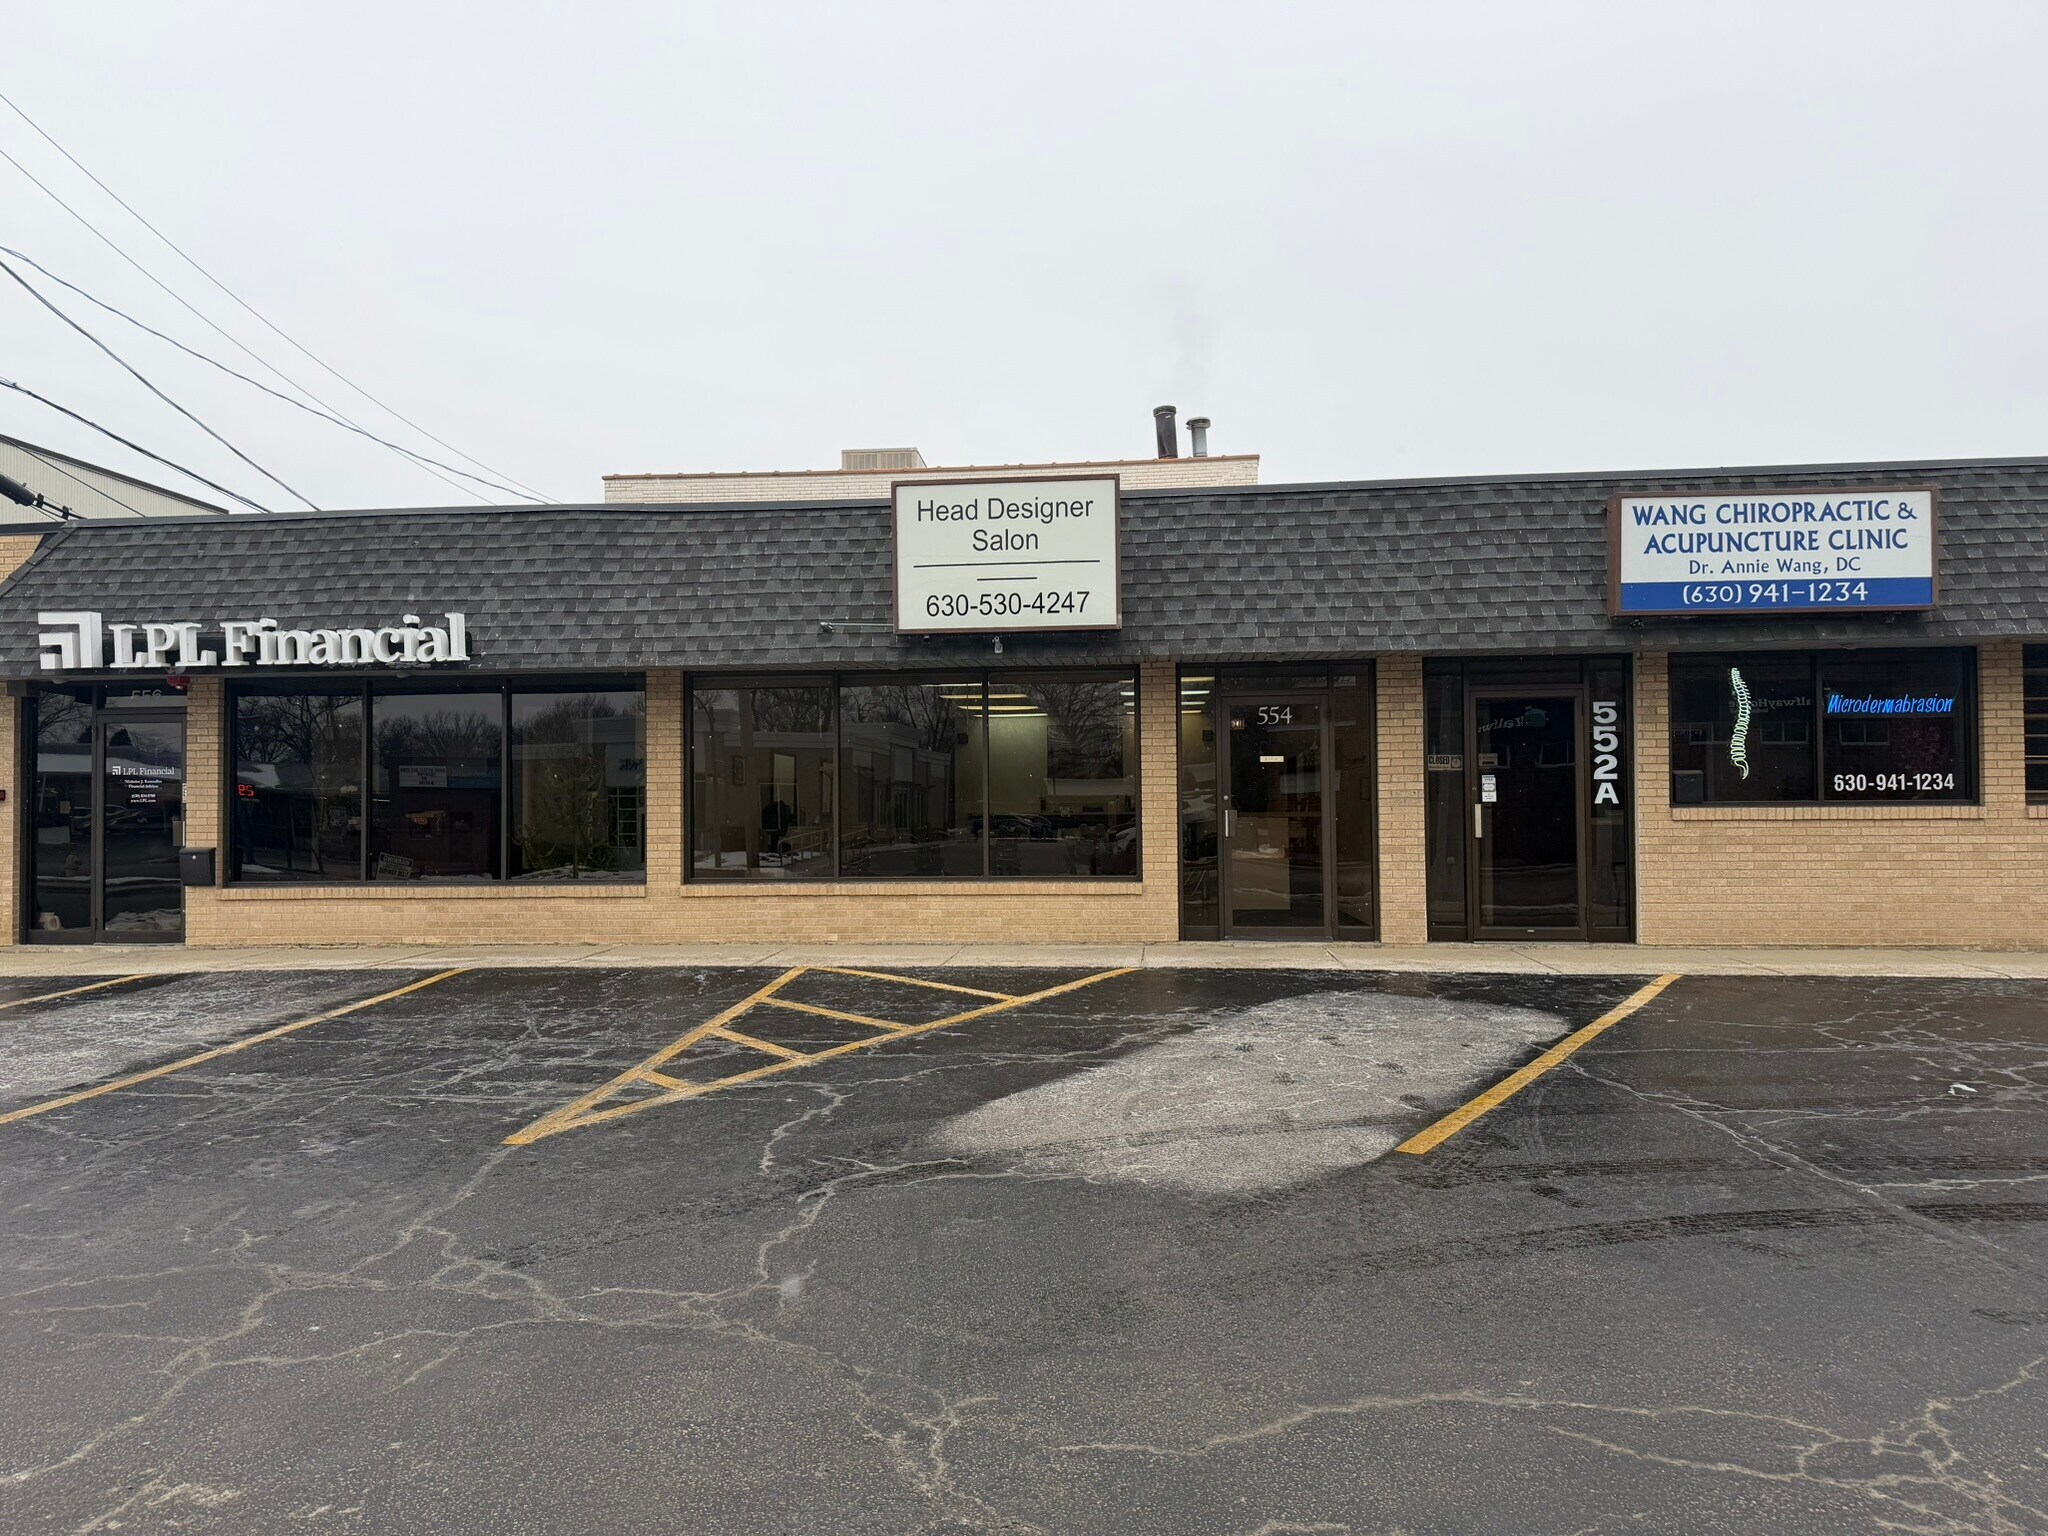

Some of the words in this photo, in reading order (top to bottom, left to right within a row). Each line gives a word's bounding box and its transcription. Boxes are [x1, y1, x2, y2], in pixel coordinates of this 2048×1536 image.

[917, 498, 978, 522] Head
[988, 497, 1094, 524] Designer
[1632, 505, 1707, 526] WANG
[1716, 500, 1890, 525] CHIROPRACTIC
[1897, 502, 1918, 520] &
[972, 529, 1039, 551] Salon
[1643, 530, 1820, 555] ACUPUNCTURE
[1828, 528, 1908, 550] CLINIC
[1689, 559, 1714, 575] Dr.
[1721, 558, 1770, 574] Annie
[1776, 558, 1829, 575] Wang,
[1836, 557, 1861, 572] DC
[926, 591, 1090, 617] 630-530-4247
[1682, 584, 1742, 605] (630)
[1749, 582, 1868, 604] 941-1234
[109, 622, 218, 668] LPL
[220, 612, 470, 667] Financial
[1827, 694, 1954, 714] Microdermabrasion
[1257, 706, 1293, 725] 554
[1428, 755, 1450, 765] CLOSED
[1592, 701, 1619, 804] 552A
[122, 767, 138, 776] LPL
[139, 766, 175, 776] Financial
[1834, 773, 1955, 792] 630-941-1234
